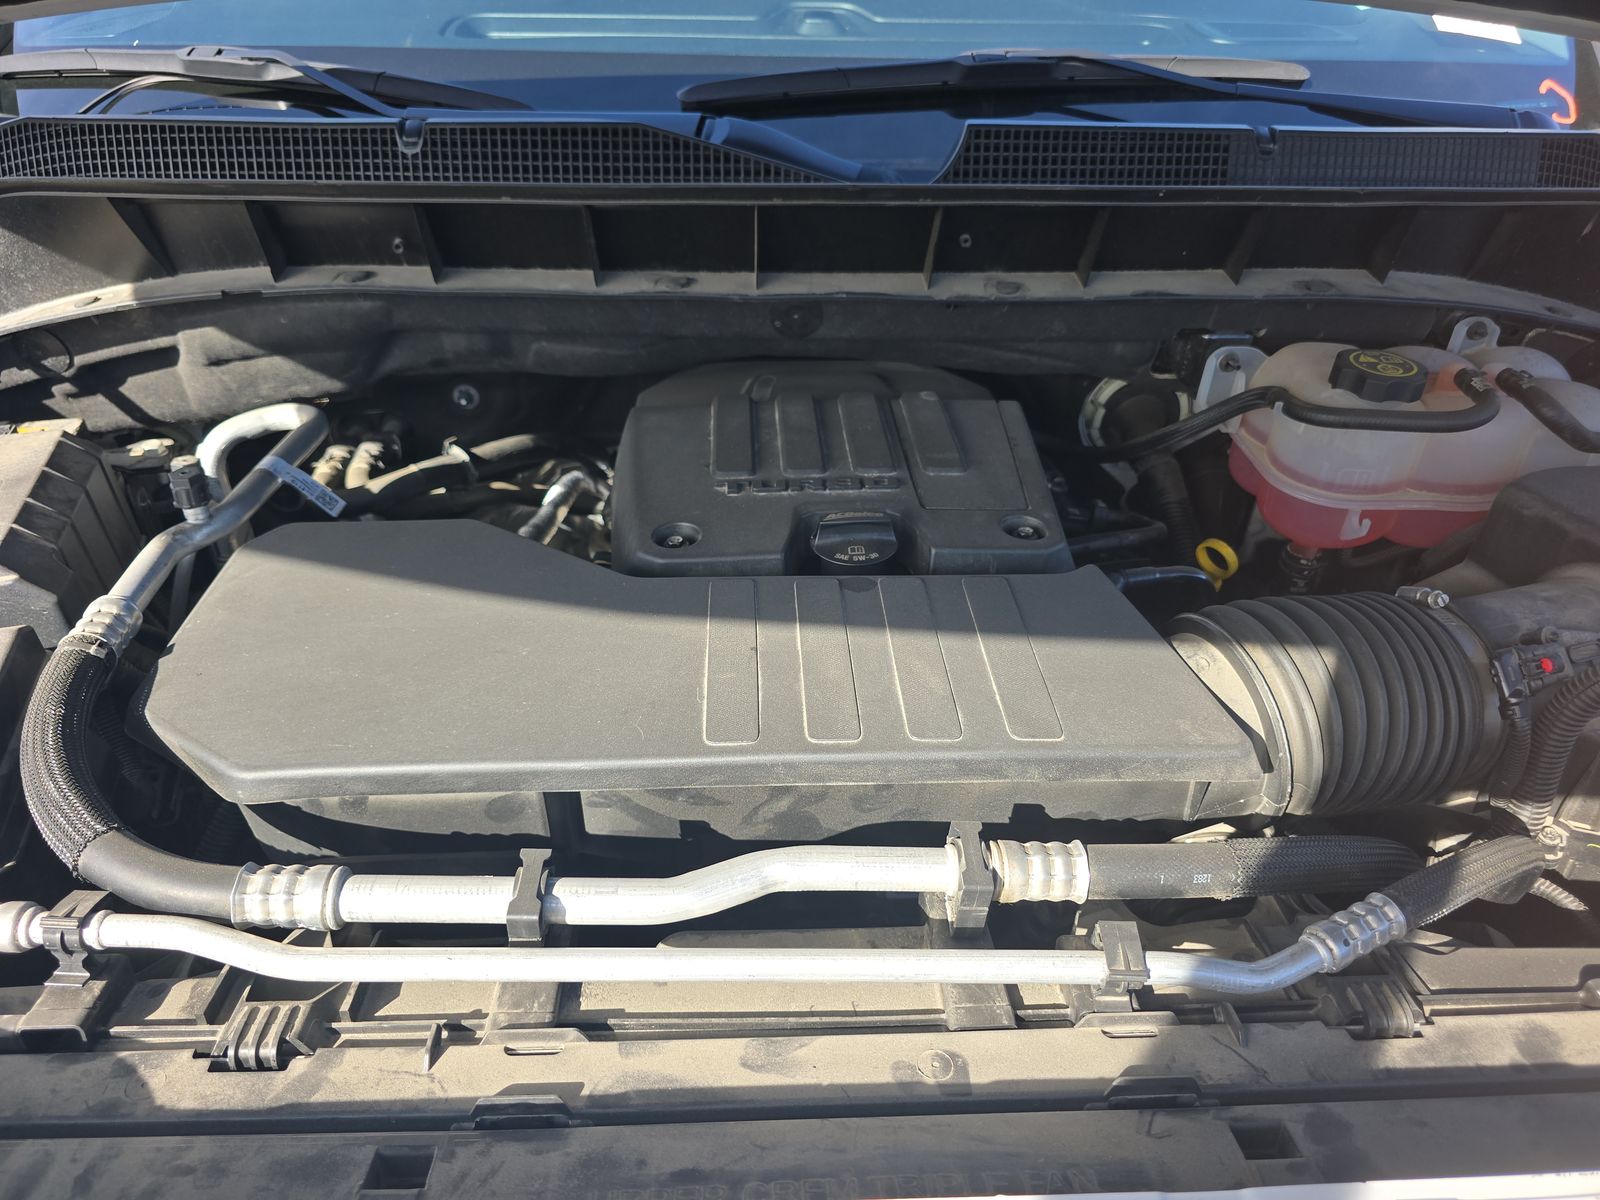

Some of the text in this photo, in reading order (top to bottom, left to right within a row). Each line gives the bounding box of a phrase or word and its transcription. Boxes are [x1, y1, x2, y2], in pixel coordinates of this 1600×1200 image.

[823, 511, 884, 521] ACDelco
[834, 552, 879, 561] SAE 5W-30
[1193, 873, 1211, 884] 1283
[1016, 1168, 1101, 1194] FAN
